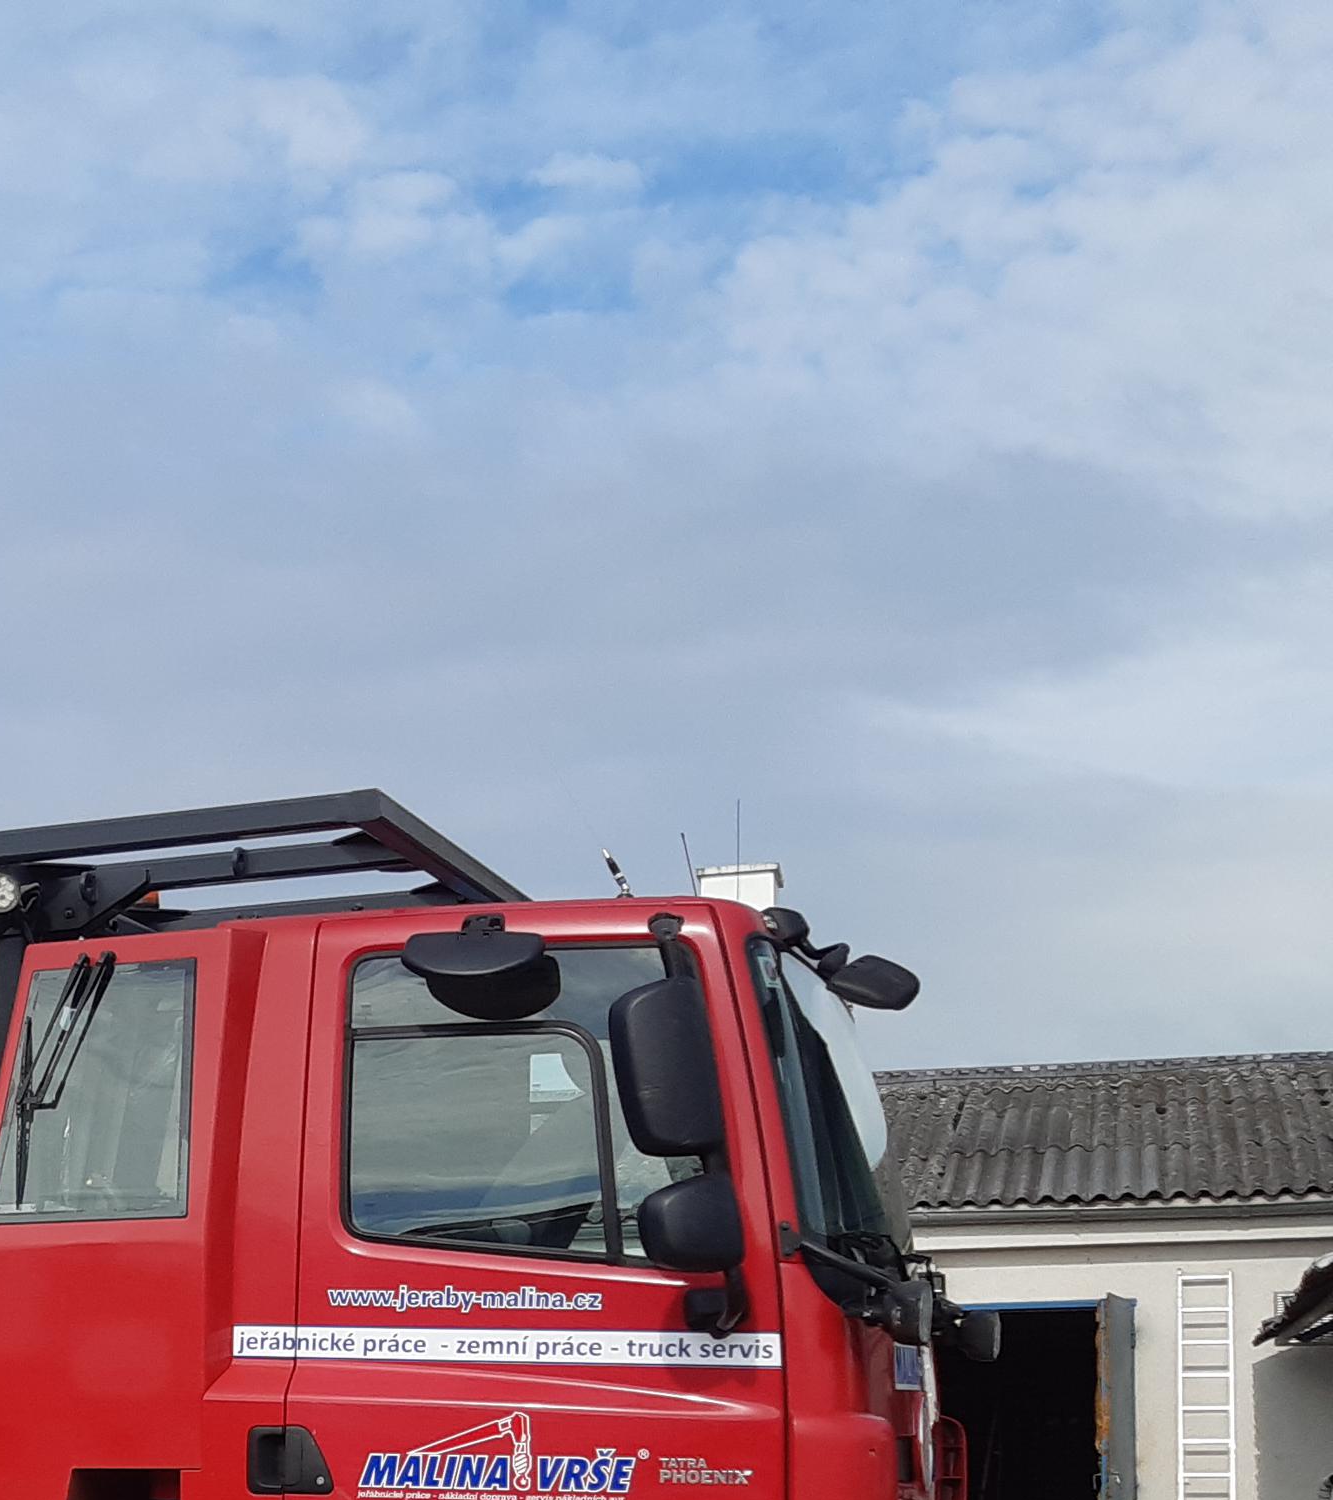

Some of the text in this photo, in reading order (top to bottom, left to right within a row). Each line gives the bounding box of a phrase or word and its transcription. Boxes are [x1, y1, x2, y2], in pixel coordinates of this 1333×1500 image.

[327, 1285, 602, 1313] www.jeraby-malina.cz
[237, 1332, 355, 1355] jeřábnické
[363, 1333, 427, 1357] práce
[455, 1334, 528, 1355] zemní
[535, 1335, 603, 1360] práce
[626, 1337, 691, 1358] truck
[698, 1338, 774, 1360] servis
[358, 1448, 635, 1492] MALINA VRŠE
[658, 1457, 707, 1468] TATRA
[659, 1469, 753, 1485] PHOENIX
